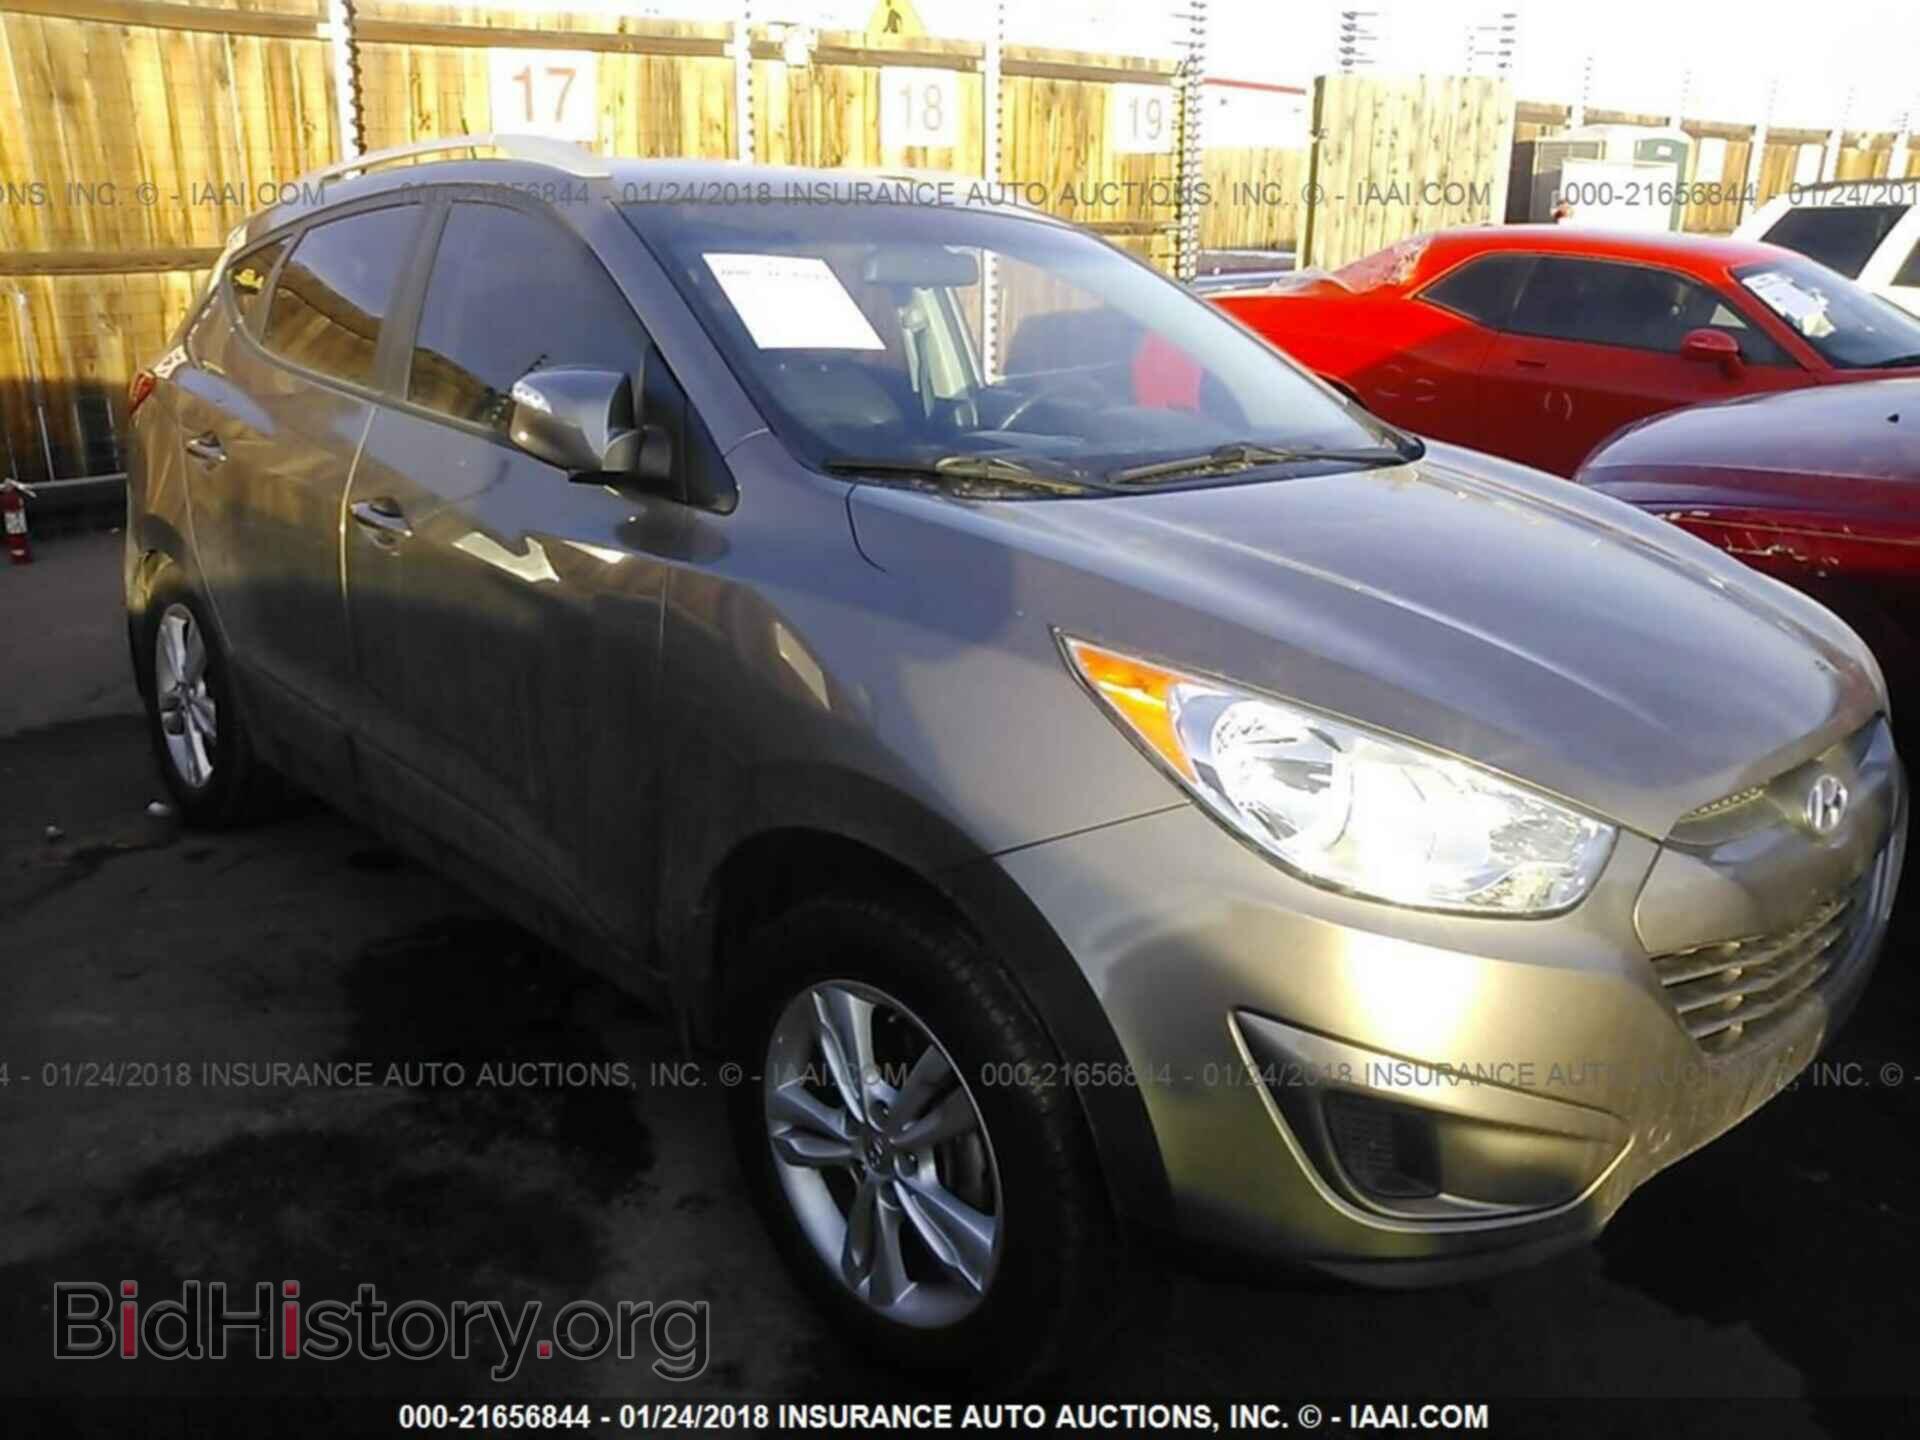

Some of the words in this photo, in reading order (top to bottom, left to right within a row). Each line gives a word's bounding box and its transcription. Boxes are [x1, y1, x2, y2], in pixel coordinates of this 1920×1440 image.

[511, 65, 577, 123] 17
[902, 83, 943, 132] 18
[1127, 96, 1163, 140] 19
